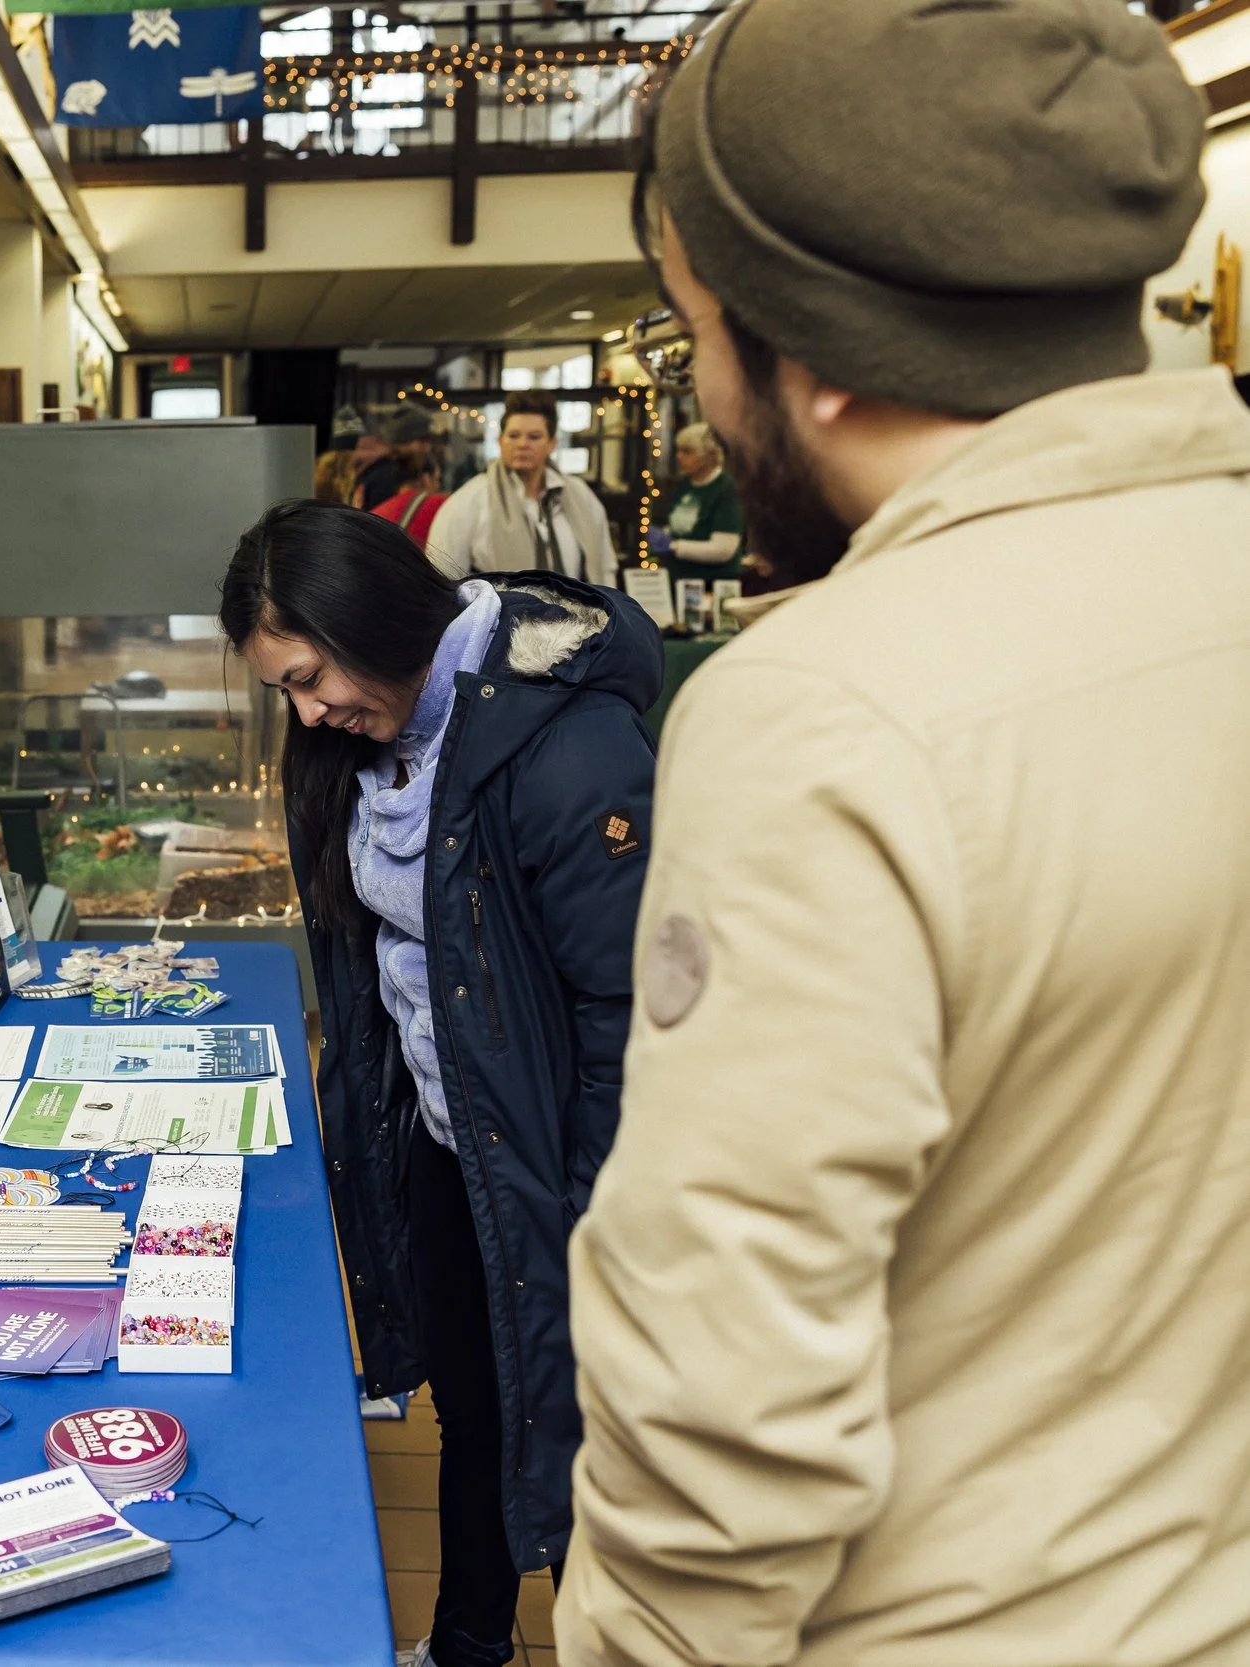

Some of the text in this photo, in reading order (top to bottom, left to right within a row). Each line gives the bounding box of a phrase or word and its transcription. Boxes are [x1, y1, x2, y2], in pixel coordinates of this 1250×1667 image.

[612, 840, 638, 854] Columbia
[9, 1313, 31, 1331] ARE
[22, 1310, 59, 1343] ALONE
[75, 1416, 108, 1457] LIFELINE
[92, 1409, 155, 1460] 988
[27, 1476, 76, 1496] ALONE
